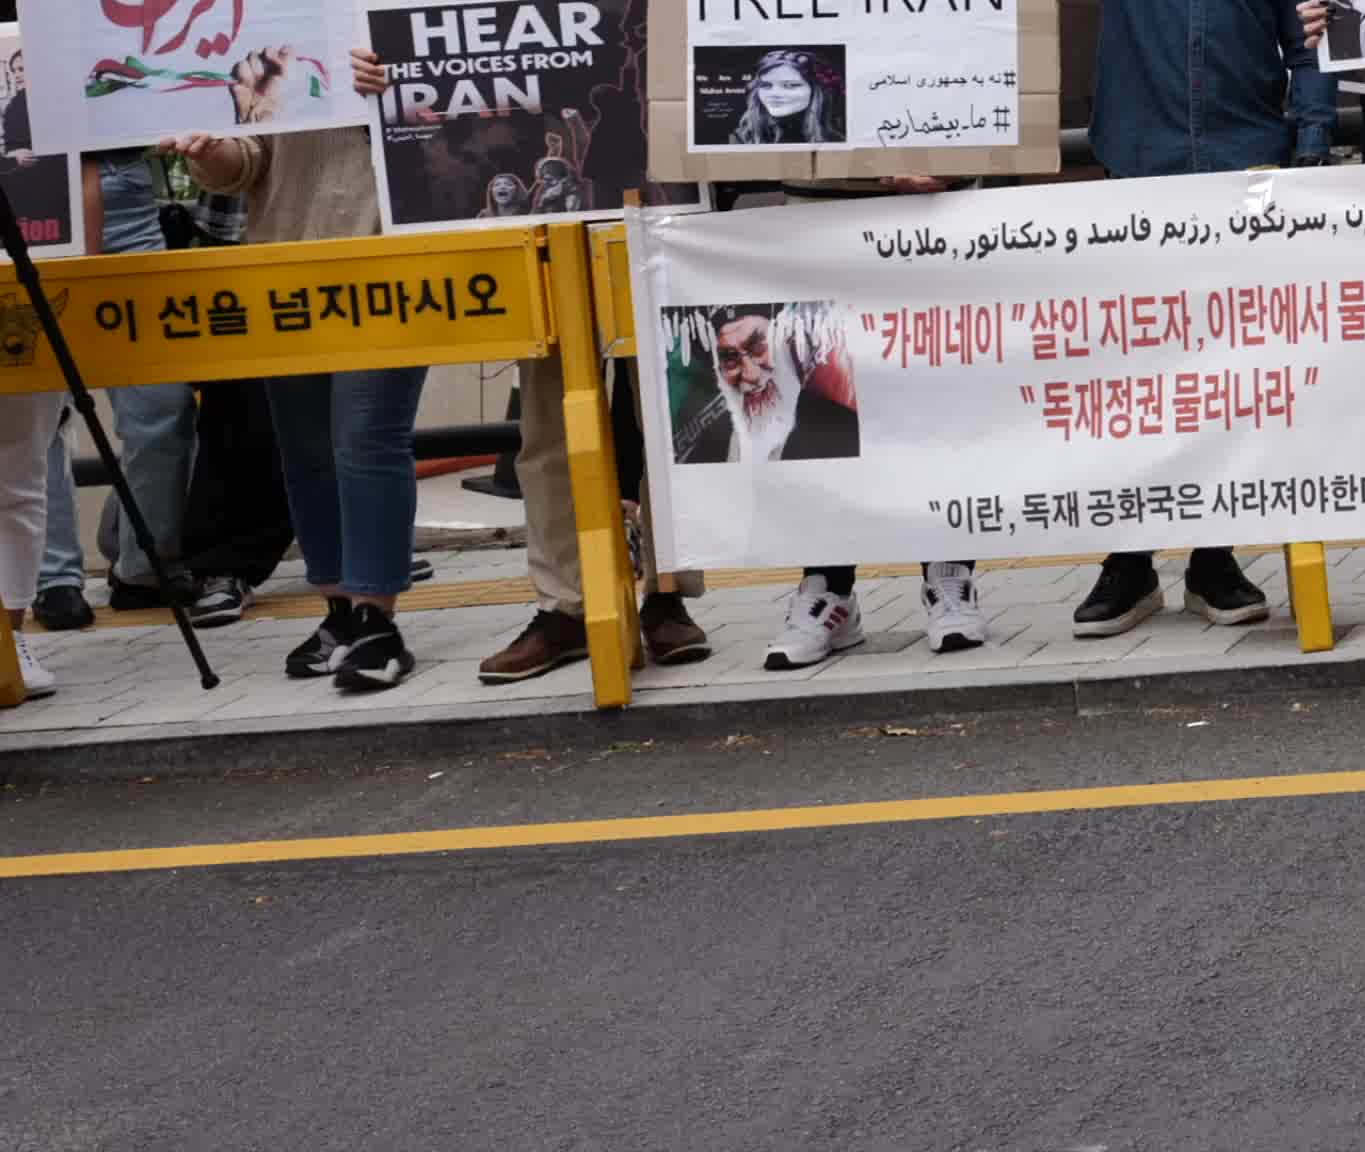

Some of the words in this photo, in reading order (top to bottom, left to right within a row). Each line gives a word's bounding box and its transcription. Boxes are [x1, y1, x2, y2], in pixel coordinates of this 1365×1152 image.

[410, 2, 604, 57] HEAR
[385, 60, 423, 79] THE
[427, 54, 516, 76] VOICES
[520, 50, 593, 71] FROM
[869, 74, 911, 90] اسلامی
[916, 76, 967, 88] جمهوری
[972, 75, 985, 87] به
[380, 75, 542, 123] IRAN
[965, 220, 1057, 260] دیکتاتور
[1065, 225, 1078, 253] و
[1087, 209, 1151, 245] فاسد
[95, 297, 137, 342] 이
[158, 282, 249, 337] 선을
[269, 272, 506, 331] 넘지마시오
[1022, 491, 1079, 529] 독재
[1087, 482, 1204, 527] 공화국은
